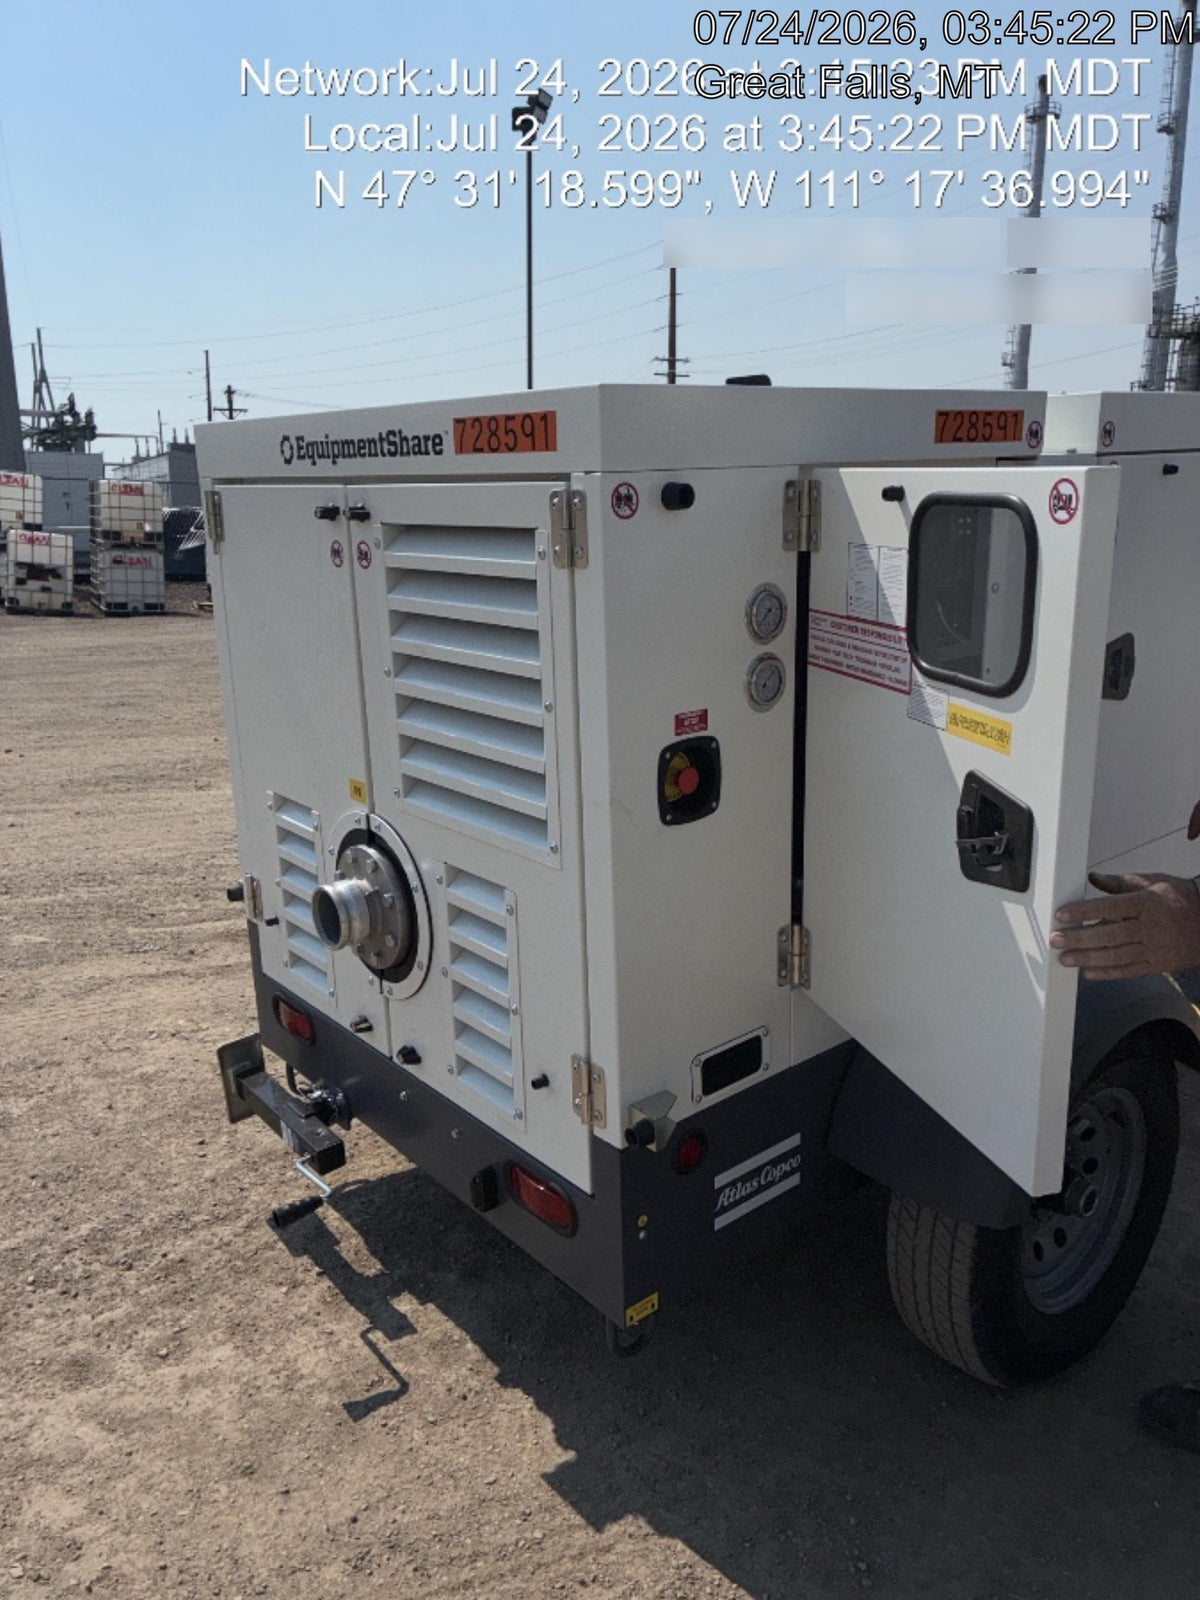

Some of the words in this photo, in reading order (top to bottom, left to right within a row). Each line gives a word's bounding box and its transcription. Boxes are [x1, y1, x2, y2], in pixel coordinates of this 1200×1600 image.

[455, 413, 551, 454] 728591
[938, 411, 1019, 444] 728591
[296, 429, 444, 466] EquipmentShare
[714, 1177, 760, 1212] Atlas
[760, 1154, 801, 1184] Copco
